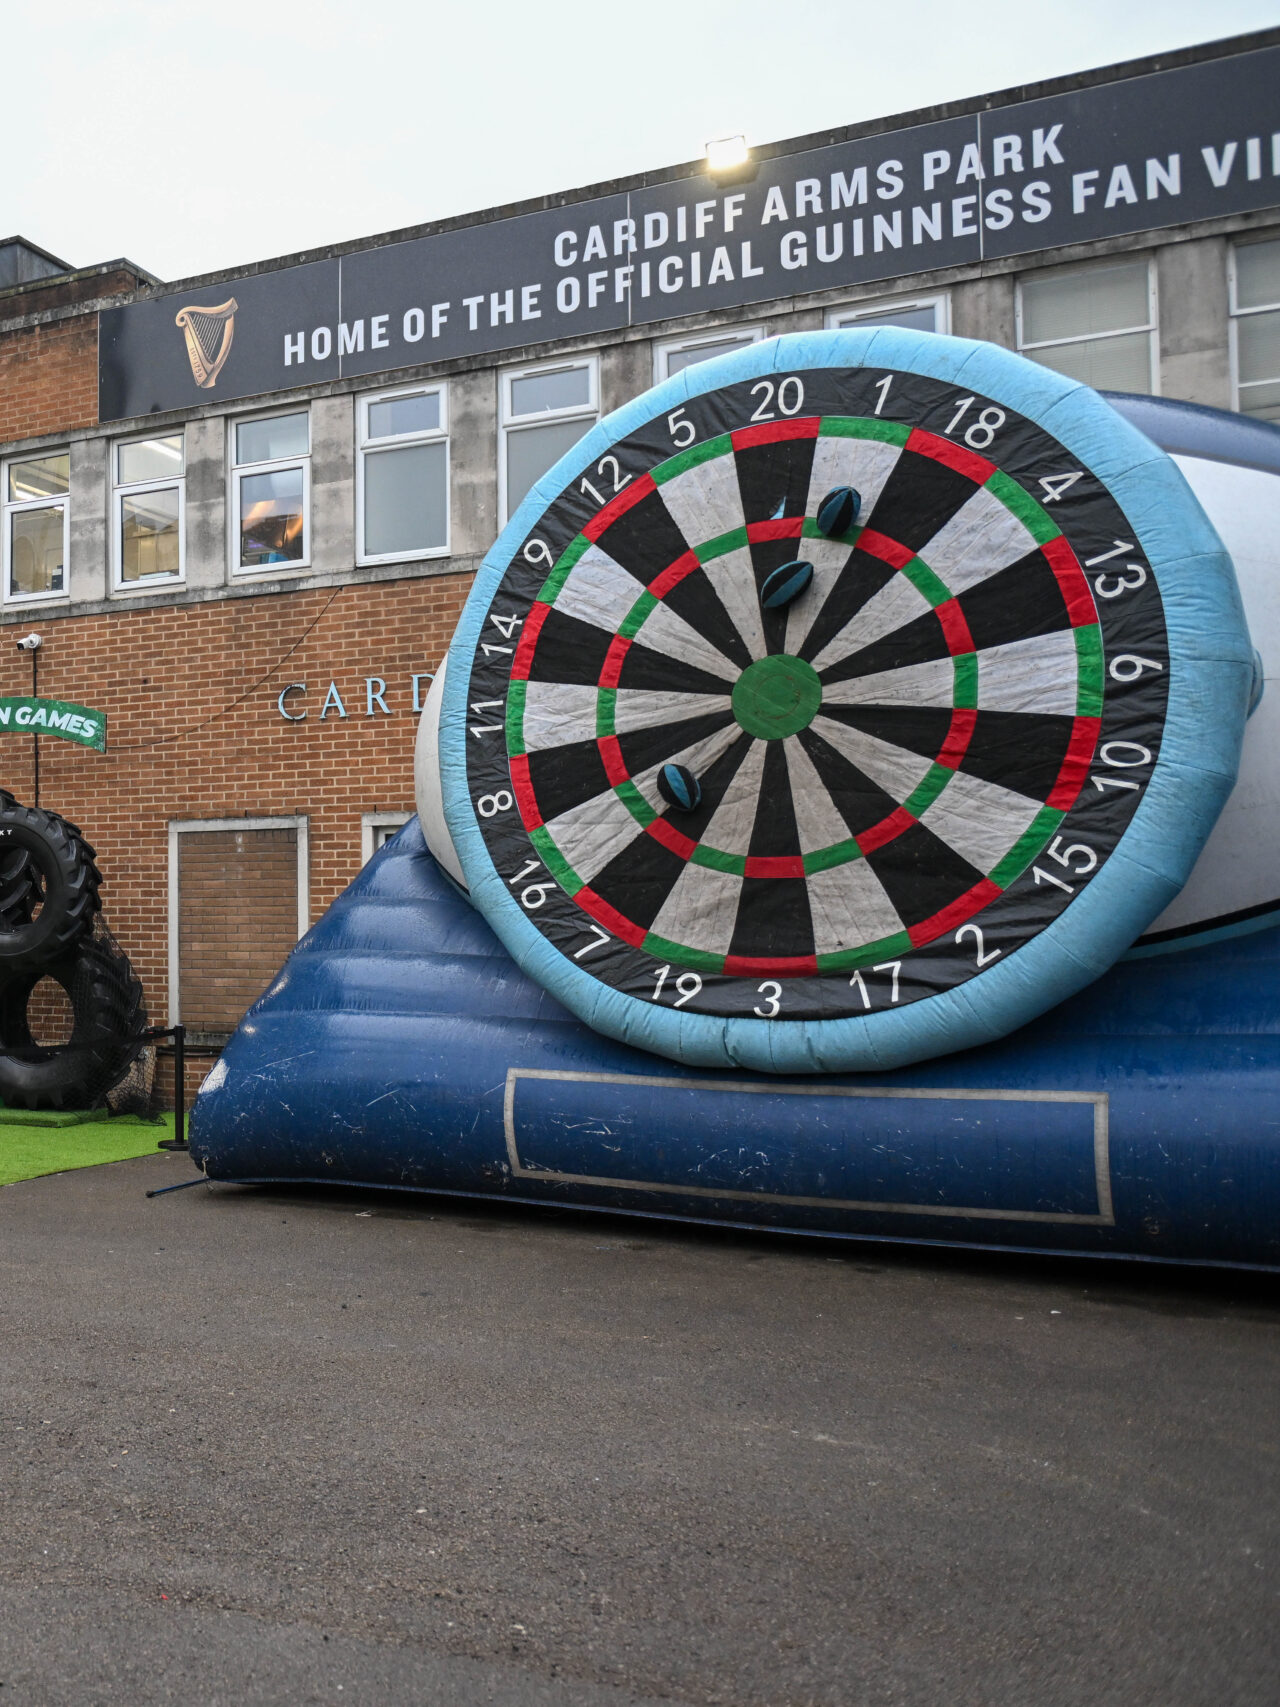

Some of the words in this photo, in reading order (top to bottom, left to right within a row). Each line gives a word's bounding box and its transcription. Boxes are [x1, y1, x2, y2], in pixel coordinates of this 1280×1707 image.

[554, 193, 745, 268] CARDIFF
[760, 160, 905, 226] ARMS
[923, 123, 1065, 192] PARK
[283, 314, 390, 366] HOME
[402, 302, 451, 343] OF
[462, 284, 541, 331] THE
[557, 240, 765, 315] OFFICIAL
[780, 181, 1052, 272] GUINNESS
[1072, 153, 1181, 215] FAN
[749, 375, 804, 421] 20
[874, 374, 894, 415] 1
[667, 407, 696, 447] 5
[943, 395, 1007, 450] 18
[579, 456, 633, 505] 12
[1038, 471, 1084, 504] 4
[522, 538, 554, 568] 9
[1084, 539, 1148, 600] 13
[480, 612, 524, 658] 14
[15, 705, 99, 738] GAMES
[469, 699, 504, 740] 11
[1090, 740, 1153, 793] 10
[476, 790, 514, 819] 8
[509, 860, 557, 912] 16
[1032, 835, 1098, 896] 15
[573, 924, 611, 960] 7
[954, 923, 1002, 969] 2
[651, 964, 703, 1010] 19
[754, 980, 783, 1020] 3
[849, 961, 902, 1011] 17
